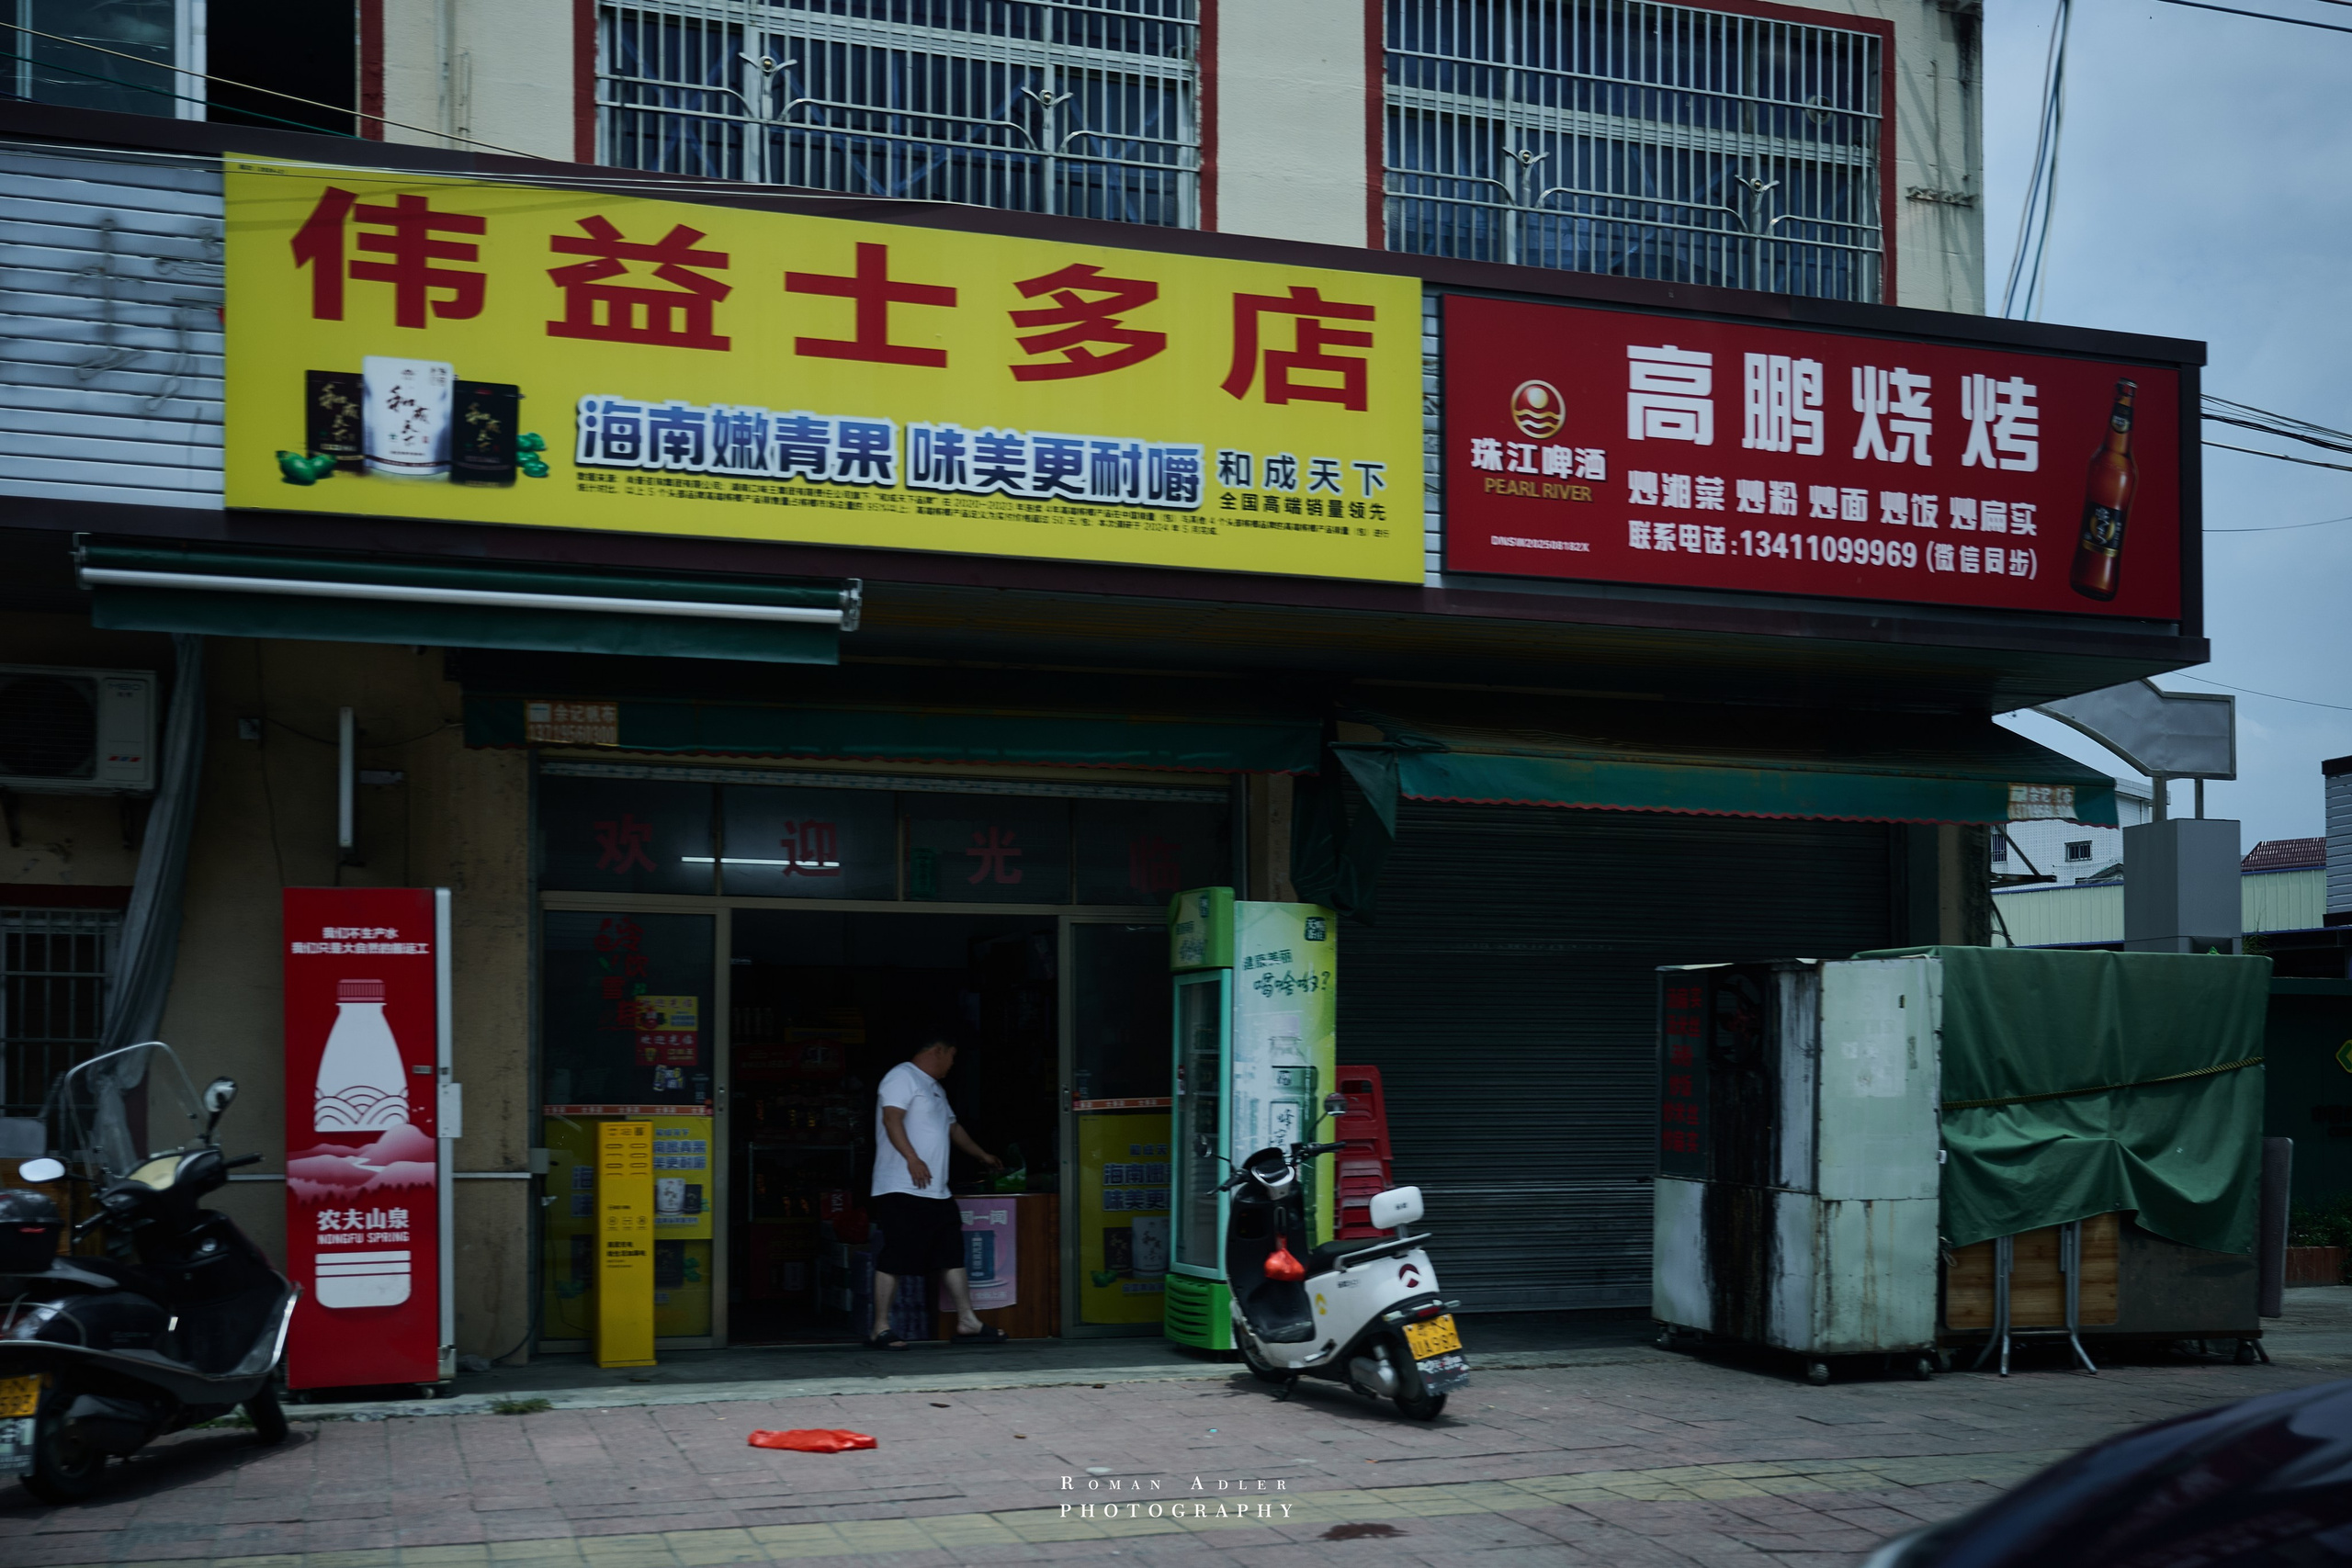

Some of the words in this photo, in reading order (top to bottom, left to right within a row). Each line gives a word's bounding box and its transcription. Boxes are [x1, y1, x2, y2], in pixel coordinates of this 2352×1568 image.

[290, 186, 1375, 412] 伟益士多店
[1626, 344, 2040, 474] 高鹏烧烤
[576, 395, 898, 488] 海南嫩青果
[906, 422, 1203, 508] 味美更耐嚼
[1218, 449, 1387, 497] 和成天下
[1470, 437, 1607, 480] 珠江啤酒
[1219, 491, 1387, 522] 全国高端销量领先
[1484, 477, 1541, 498] PEARL
[1543, 482, 1594, 502] RIVER
[593, 813, 1183, 894] 欢迎光临
[316, 1207, 410, 1231] 农夫山泉
[1103, 1189, 1170, 1212] 味美更
[316, 1233, 365, 1245] NONGFU
[367, 1231, 411, 1243] SPRING
